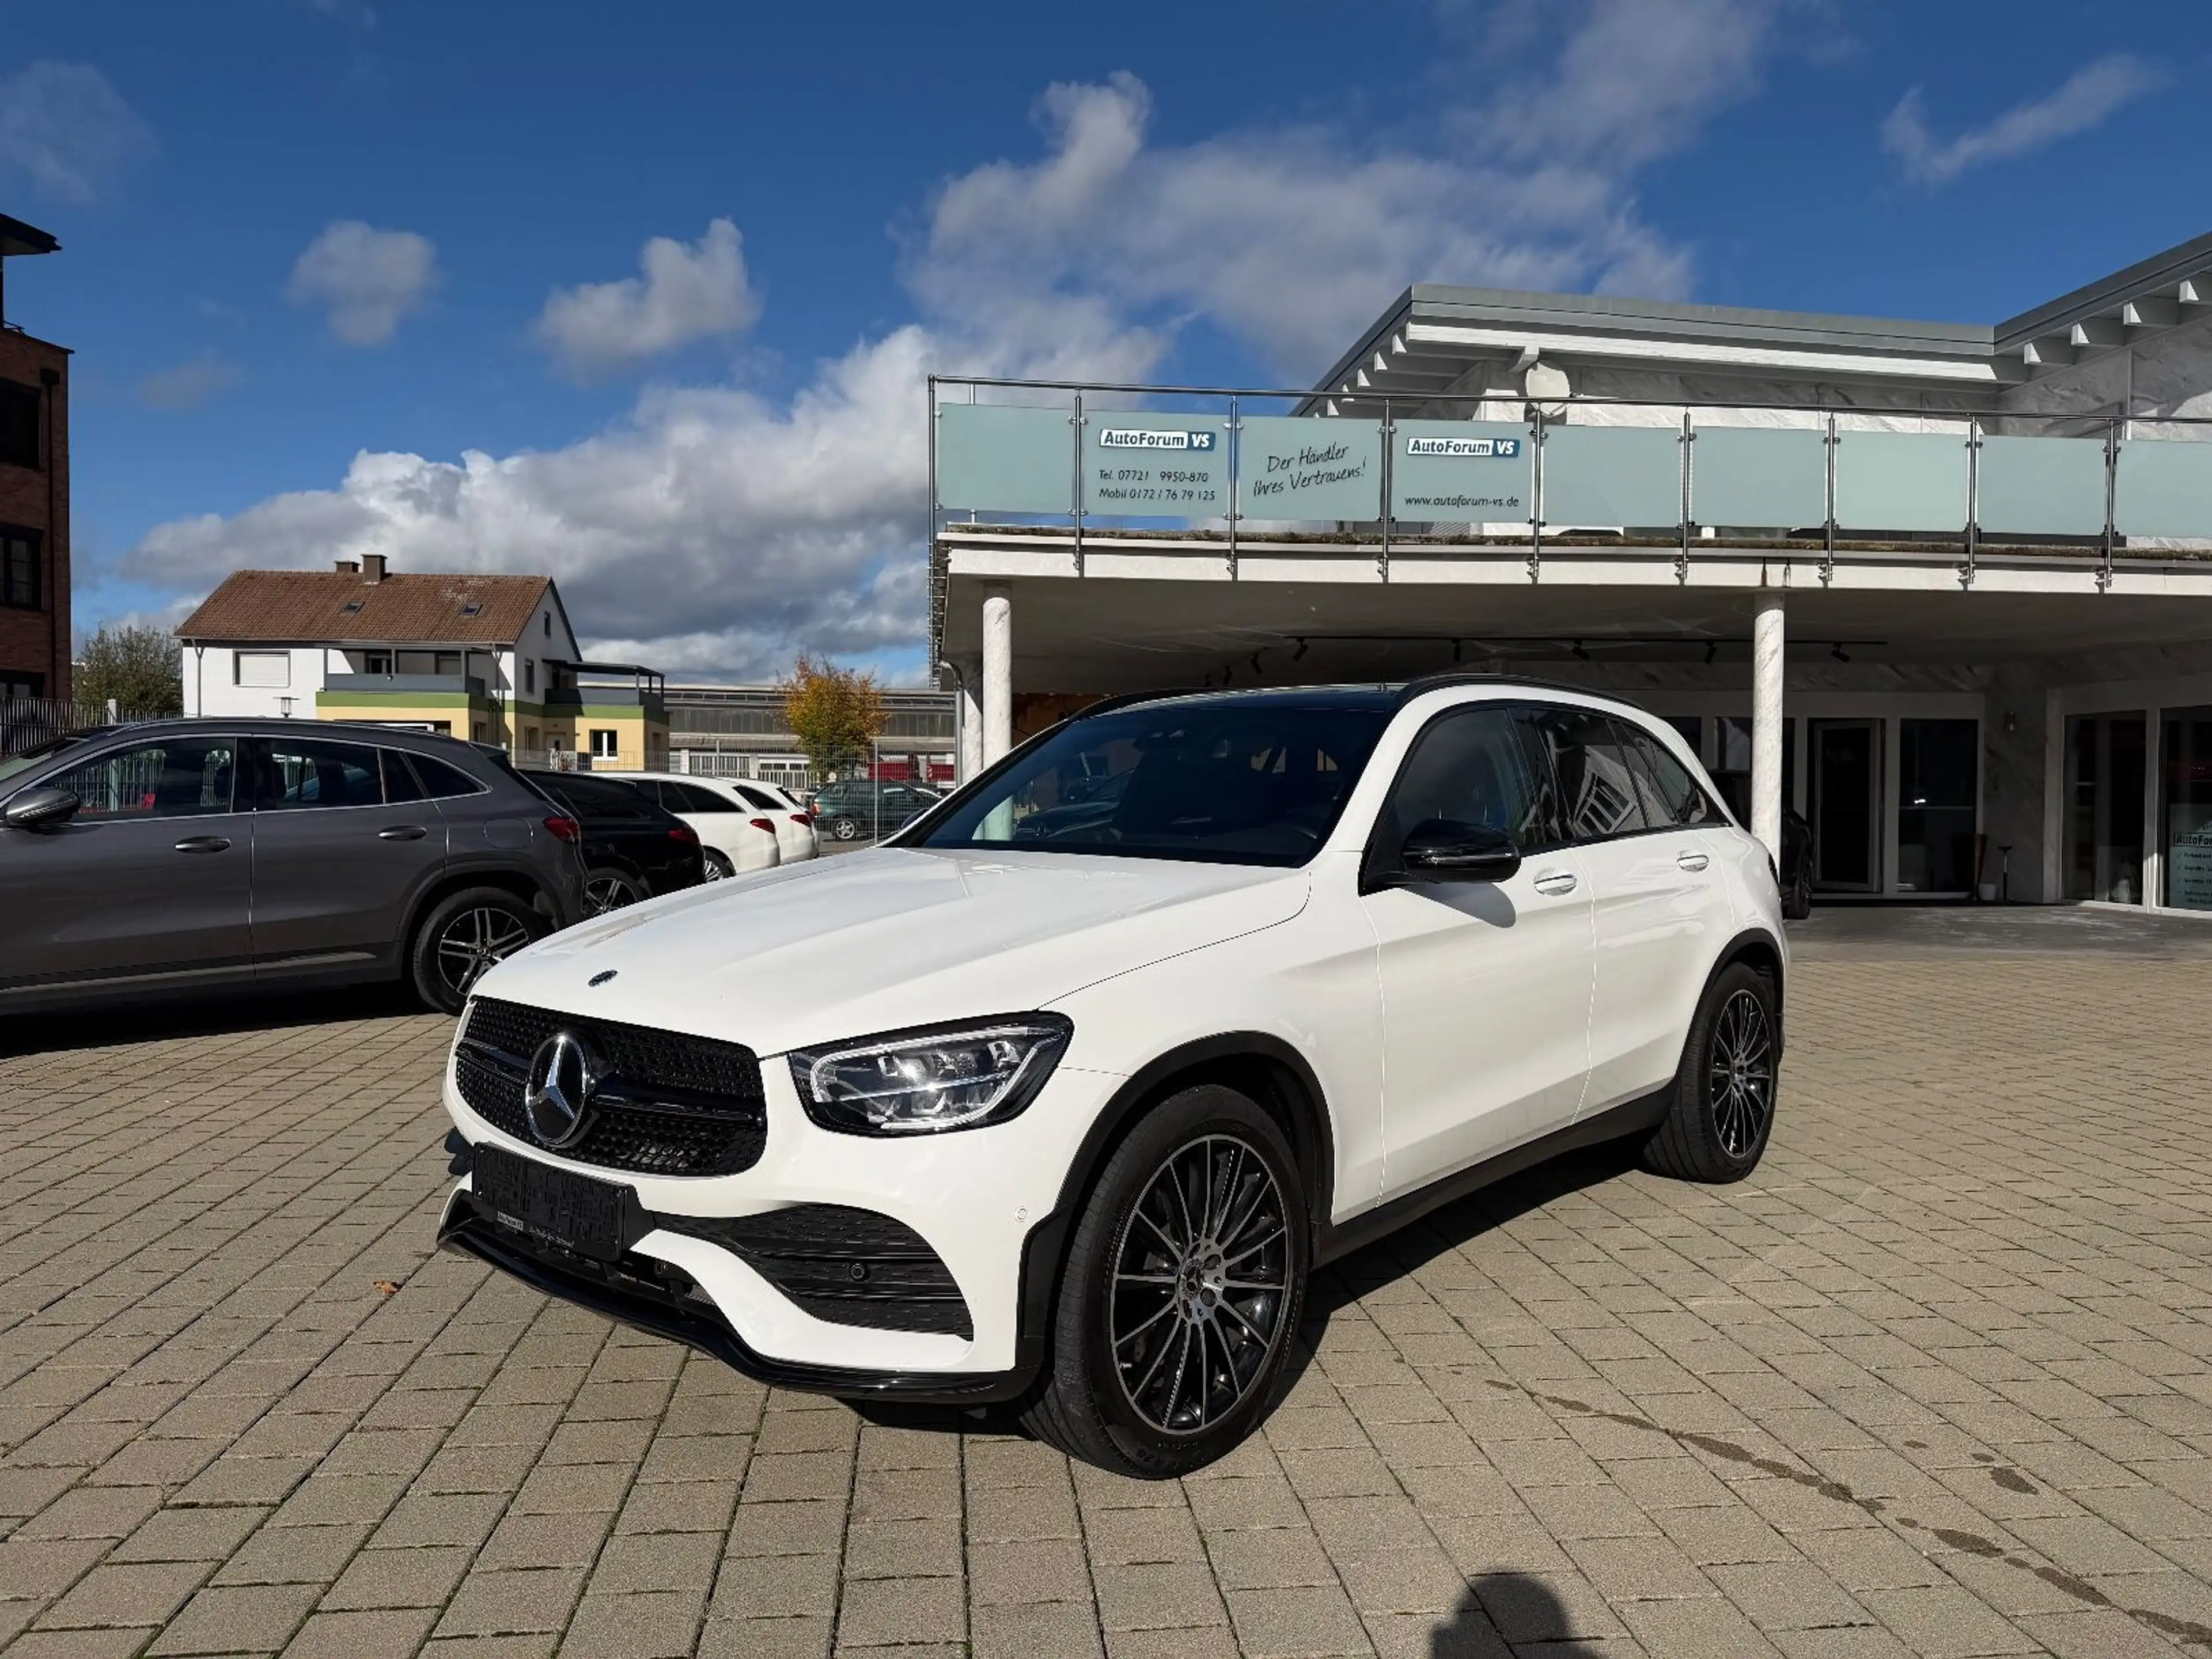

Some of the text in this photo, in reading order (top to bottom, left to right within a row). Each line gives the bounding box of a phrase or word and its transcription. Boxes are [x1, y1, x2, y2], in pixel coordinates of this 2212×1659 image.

[1104, 431, 1210, 448] AutoForum VS
[1411, 440, 1514, 454] AutoForum VS
[1267, 441, 1349, 472] Der Händler
[1099, 470, 1209, 482] Tel. 07721 9950-870
[1253, 456, 1367, 497] Ihres Vertrauens!
[1099, 488, 1126, 498] Mobil
[1129, 489, 1154, 499] 0172
[1165, 490, 1178, 500] 76
[1181, 490, 1194, 500] 79
[1198, 491, 1216, 501] 125
[1404, 495, 1519, 508] www.autoforum-vs.de
